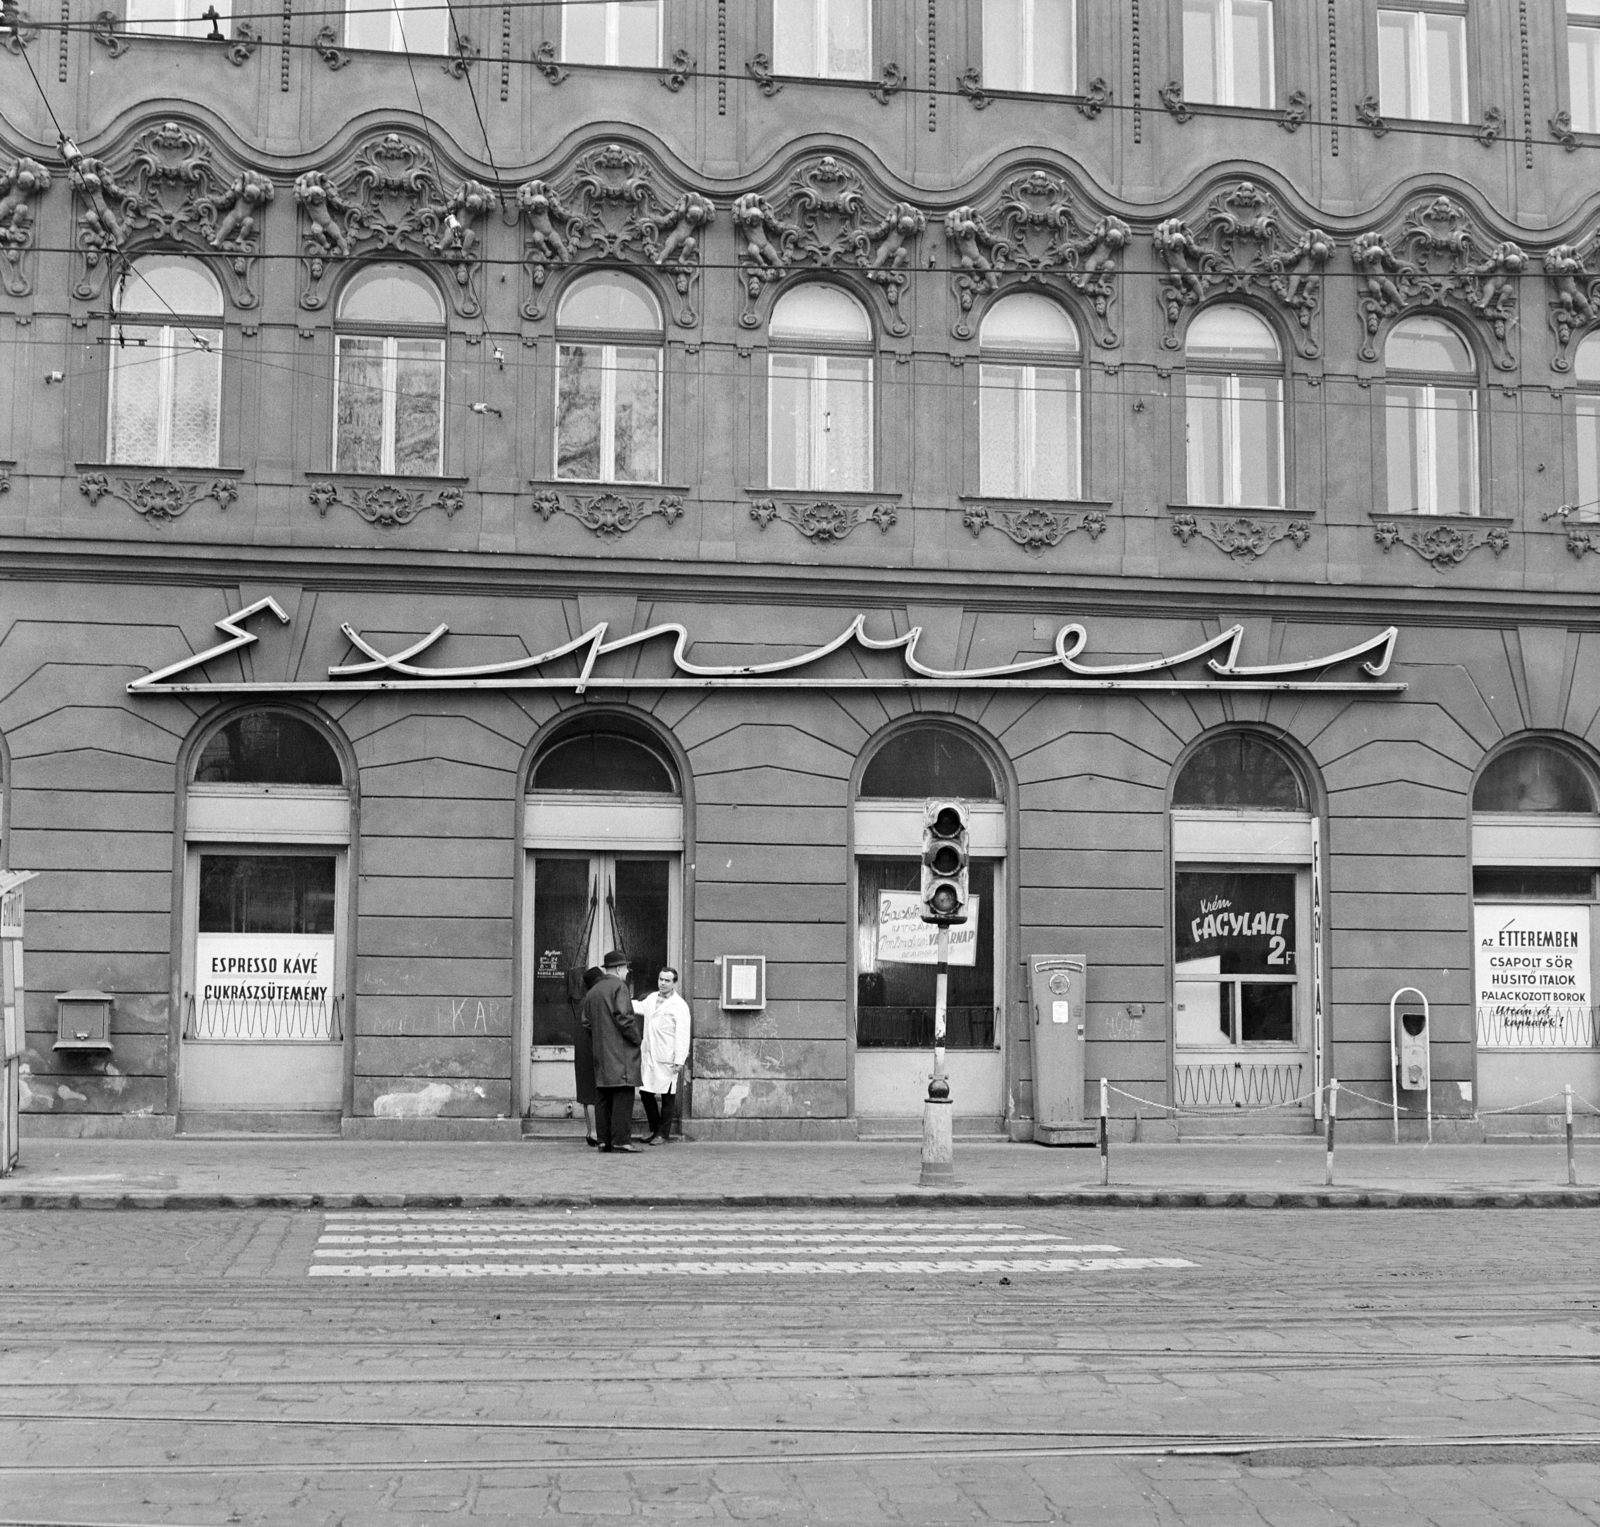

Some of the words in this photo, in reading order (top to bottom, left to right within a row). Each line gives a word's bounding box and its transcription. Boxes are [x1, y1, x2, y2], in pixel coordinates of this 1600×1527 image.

[127, 595, 1406, 693] Express
[880, 899, 921, 924] Zacsk
[1200, 895, 1232, 914] Krém
[1191, 911, 1289, 943] FAGYLALT
[1482, 939, 1493, 947] AZ
[1499, 918, 1578, 948] ÉTTEREMBEN
[1267, 935, 1286, 965] 2
[212, 957, 278, 973] ESPRESSO
[283, 952, 319, 974] KÁVÉ
[1490, 957, 1542, 968] CSAPOLT
[1546, 955, 1573, 969] SÖR
[204, 979, 328, 1001] CUKRÁSZSÜTEMÉNY
[1539, 974, 1576, 985] ITALOK
[1481, 991, 1552, 1002] PALACKOZOTT
[1553, 992, 1586, 1002] BOROK
